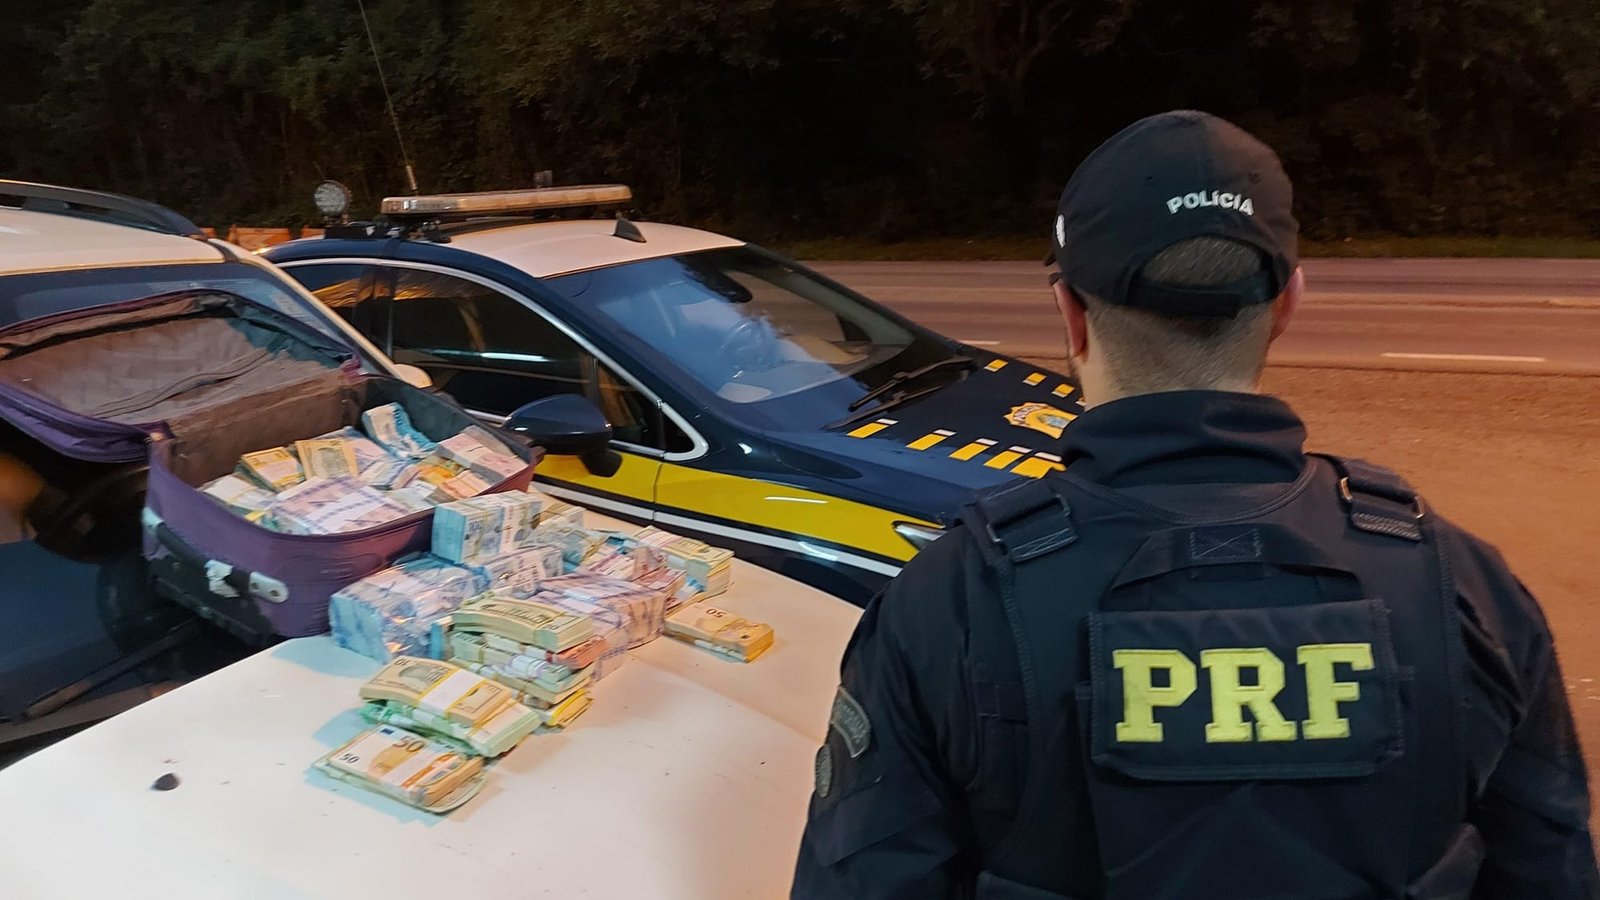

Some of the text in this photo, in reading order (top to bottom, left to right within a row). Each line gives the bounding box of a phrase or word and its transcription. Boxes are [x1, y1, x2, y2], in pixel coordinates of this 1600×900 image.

[1166, 190, 1255, 217] POLÍCIA
[706, 609, 726, 618] 50
[1112, 643, 1375, 742] PRF
[393, 735, 425, 752] 50
[339, 753, 361, 764] 50
